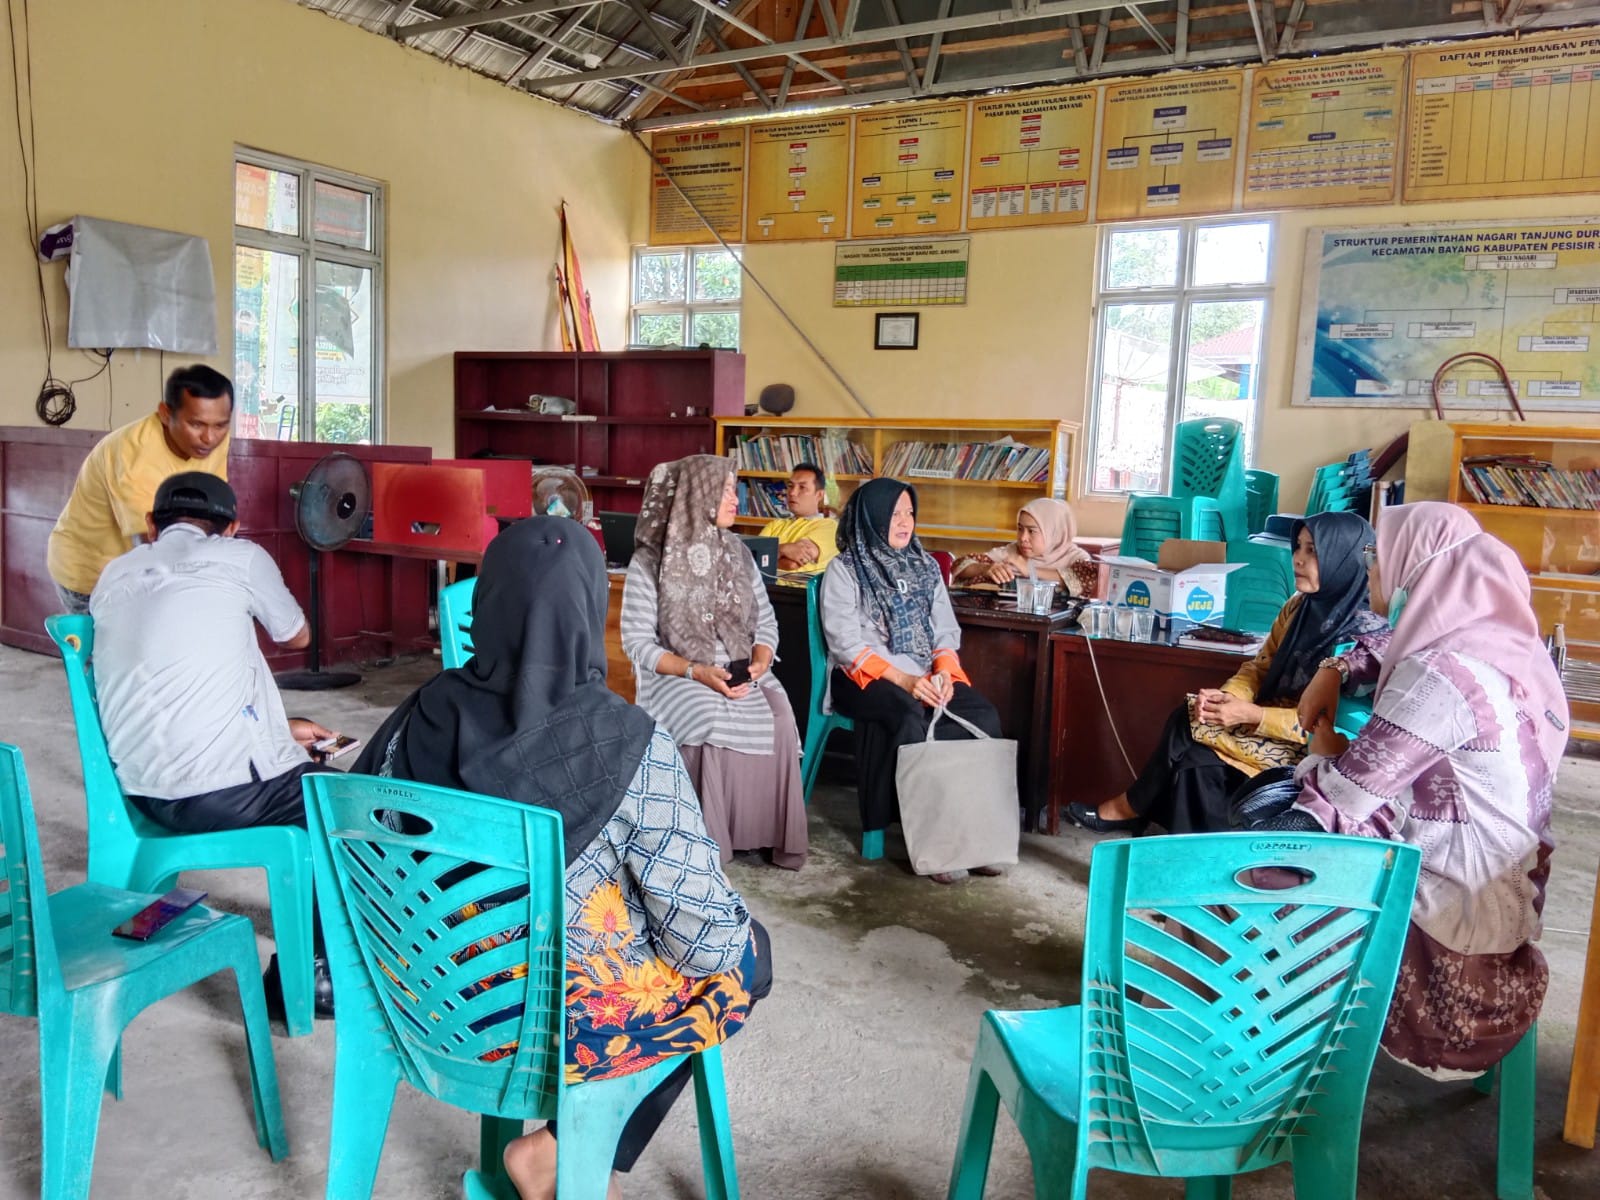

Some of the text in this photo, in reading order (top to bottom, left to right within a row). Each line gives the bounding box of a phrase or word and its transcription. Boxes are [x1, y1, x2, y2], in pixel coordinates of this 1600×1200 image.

[1440, 51, 1481, 62] DAFTAR
[1485, 41, 1577, 57] PERKEMBANGAN
[1333, 236, 1389, 248] STRUKTUR
[1391, 233, 1473, 245] PEMERINTAHAN
[1476, 232, 1518, 242] NAGARI
[1520, 230, 1573, 241] TANJUNG
[1371, 246, 1435, 257] KECAMATAN
[1438, 244, 1480, 254] BAYANG
[1483, 242, 1548, 253] KABUPATEN
[1551, 241, 1595, 251] PESISIR
[1128, 594, 1150, 607] JEJE
[1188, 600, 1213, 611] JEJE
